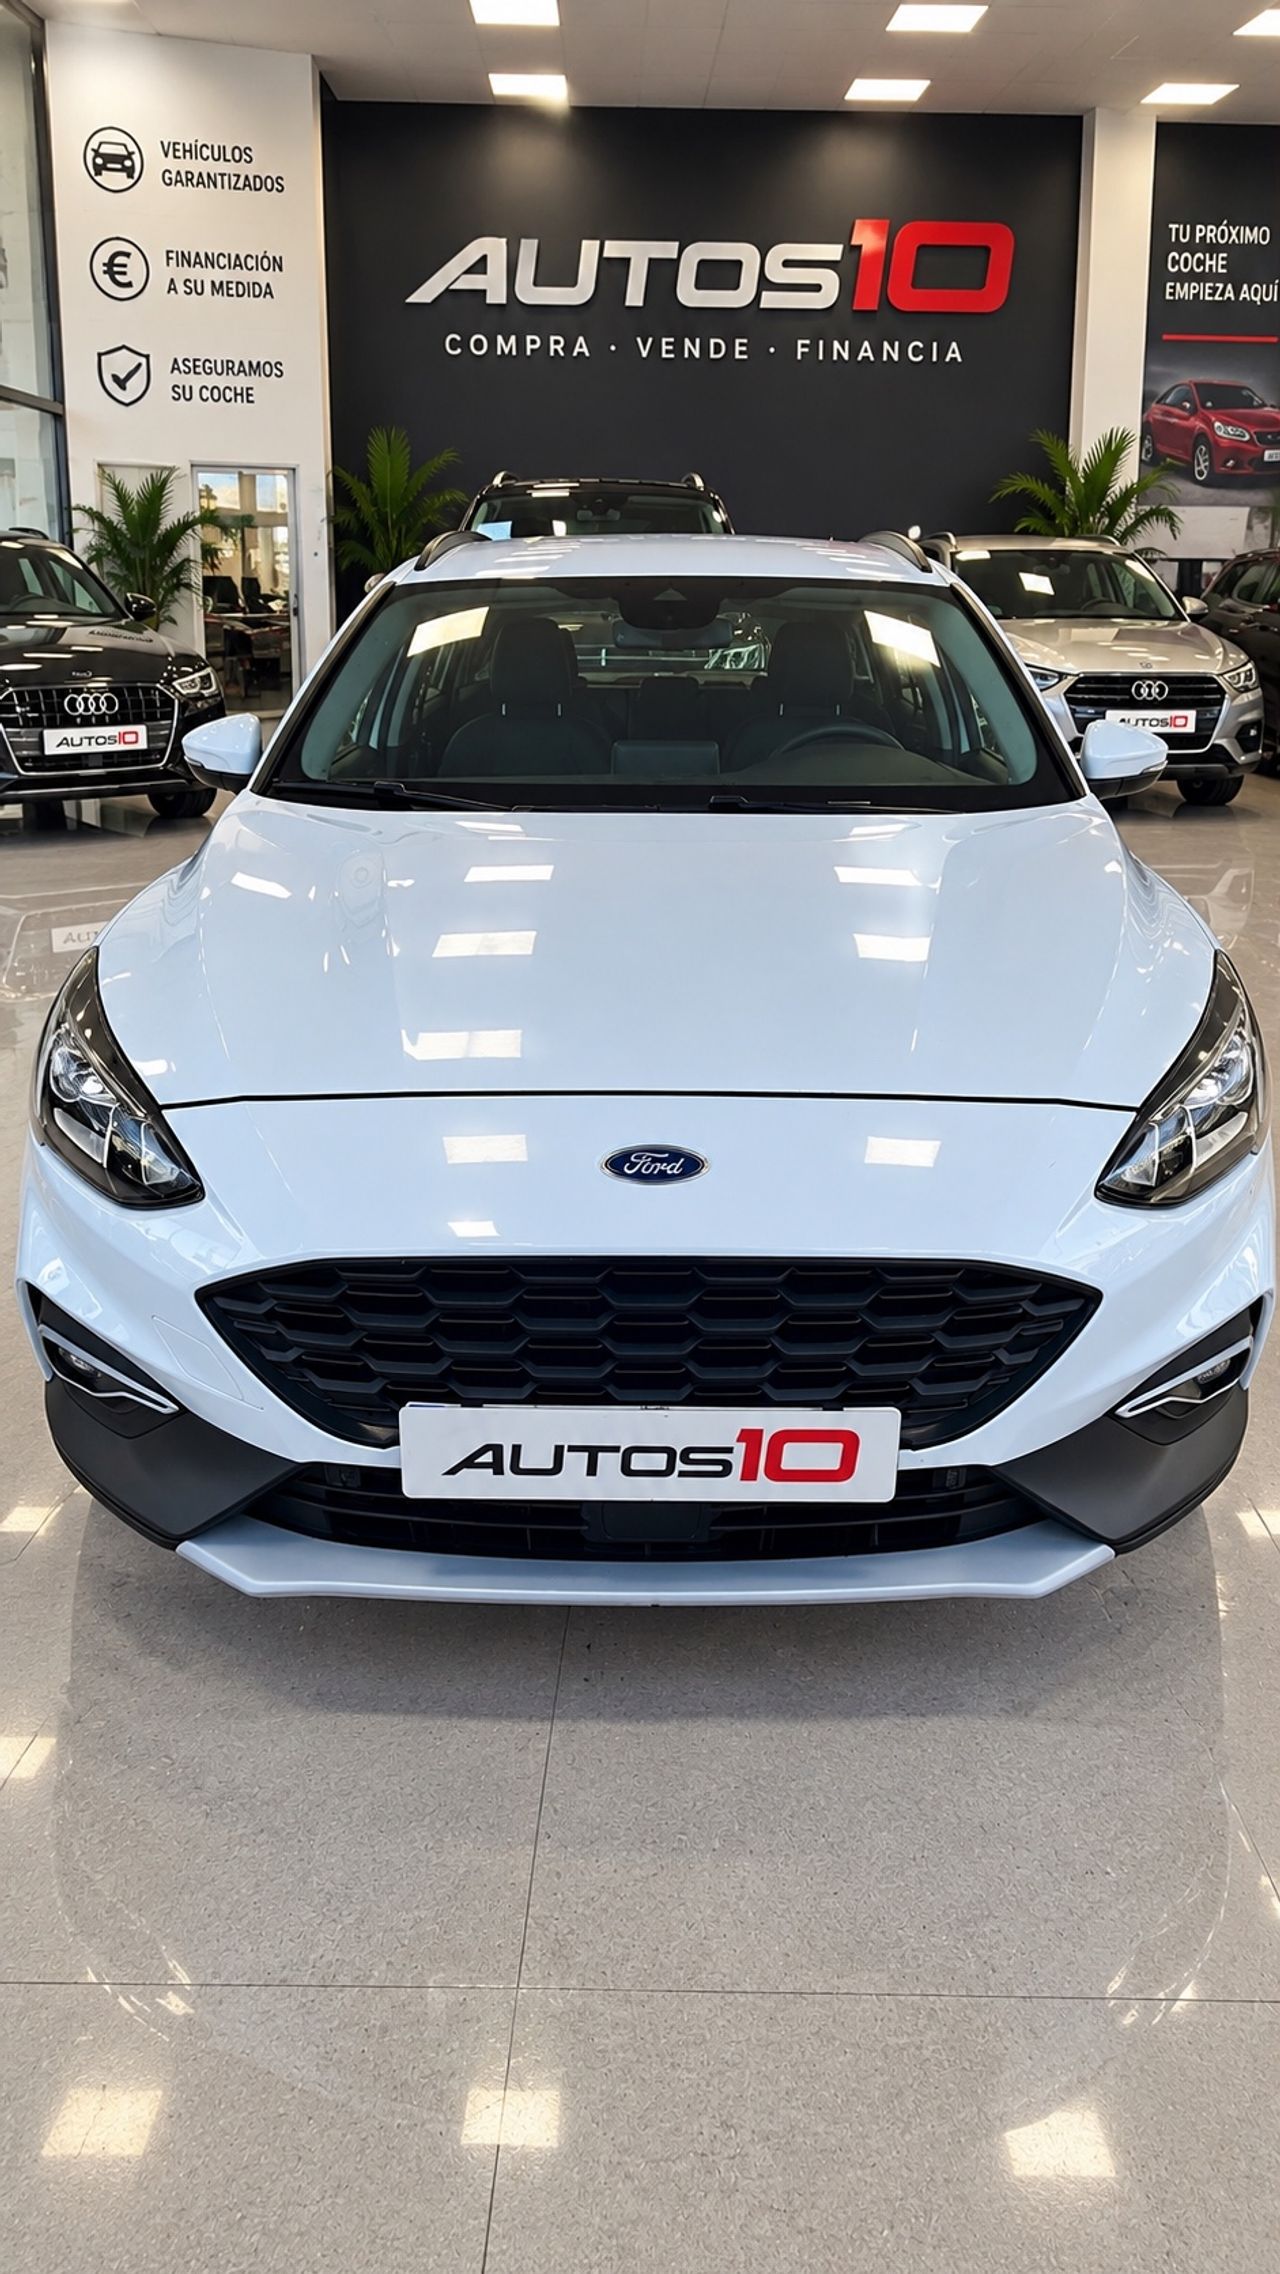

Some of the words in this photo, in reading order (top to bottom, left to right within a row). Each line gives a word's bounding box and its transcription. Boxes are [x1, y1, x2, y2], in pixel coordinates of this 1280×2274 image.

[160, 138, 254, 165] VEHÍCULOS
[161, 168, 285, 194] GARANTIZADOS
[1168, 223, 1191, 243] TU
[1195, 219, 1270, 245] PRÓXIMO
[165, 249, 284, 273] FINANCIACIÓN
[405, 218, 1015, 313] AUTOS10
[1167, 251, 1228, 273] COCHE
[166, 277, 179, 295] A
[183, 278, 205, 297] SU
[210, 279, 275, 300] MEDIDA
[1165, 281, 1235, 301] EMPIEZA
[1238, 279, 1279, 306] AQUÍ
[445, 333, 590, 357] COMPRA
[636, 336, 748, 359] VENDE
[796, 339, 962, 362] FINANCIA
[170, 357, 284, 379] ASEGURAMOS
[171, 383, 193, 402] SU
[198, 384, 255, 404] COCHE
[55, 730, 139, 748] AUTOS10
[624, 1152, 685, 1174] Ford
[441, 1428, 860, 1483] AUTOS10
